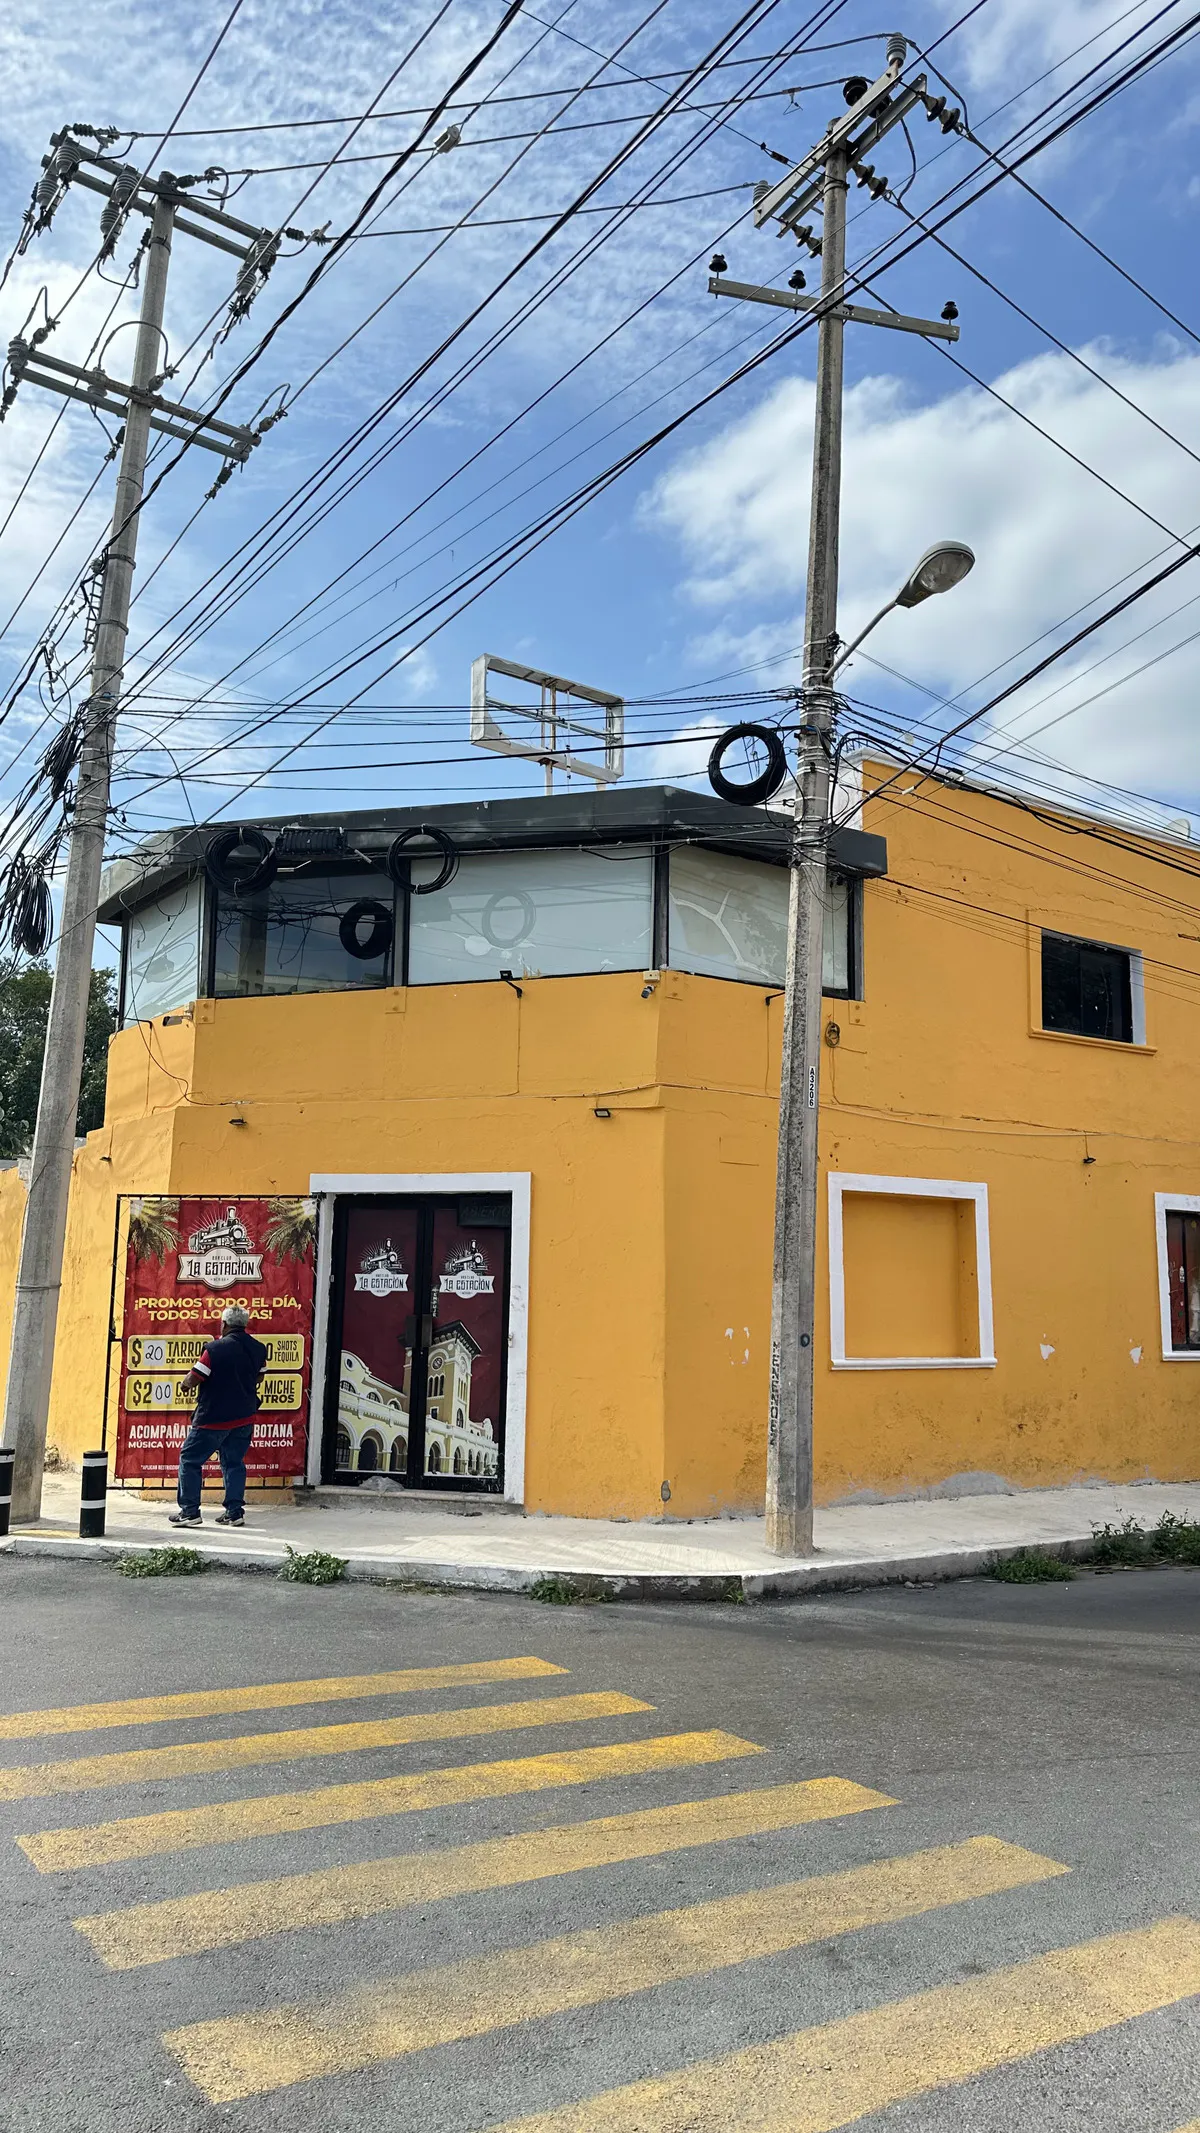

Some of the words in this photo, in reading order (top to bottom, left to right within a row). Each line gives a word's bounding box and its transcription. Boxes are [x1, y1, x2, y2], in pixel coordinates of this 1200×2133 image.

[187, 1259, 201, 1277] LA
[205, 1257, 254, 1275] ESTACIÓN
[134, 1297, 203, 1311] ¡PROMOS
[205, 1297, 248, 1308] TODO
[251, 1297, 268, 1308] EL
[272, 1295, 302, 1310] DÍA,
[148, 1309, 200, 1321] TODOS
[203, 1309, 222, 1319] LO
[277, 1340, 297, 1351] SHOTS
[274, 1351, 300, 1363] TEQUILA
[264, 1380, 296, 1395] MICHE
[260, 1395, 295, 1404] ITROS
[253, 1423, 294, 1438] BOTANA
[128, 1439, 164, 1448] MÚSICA
